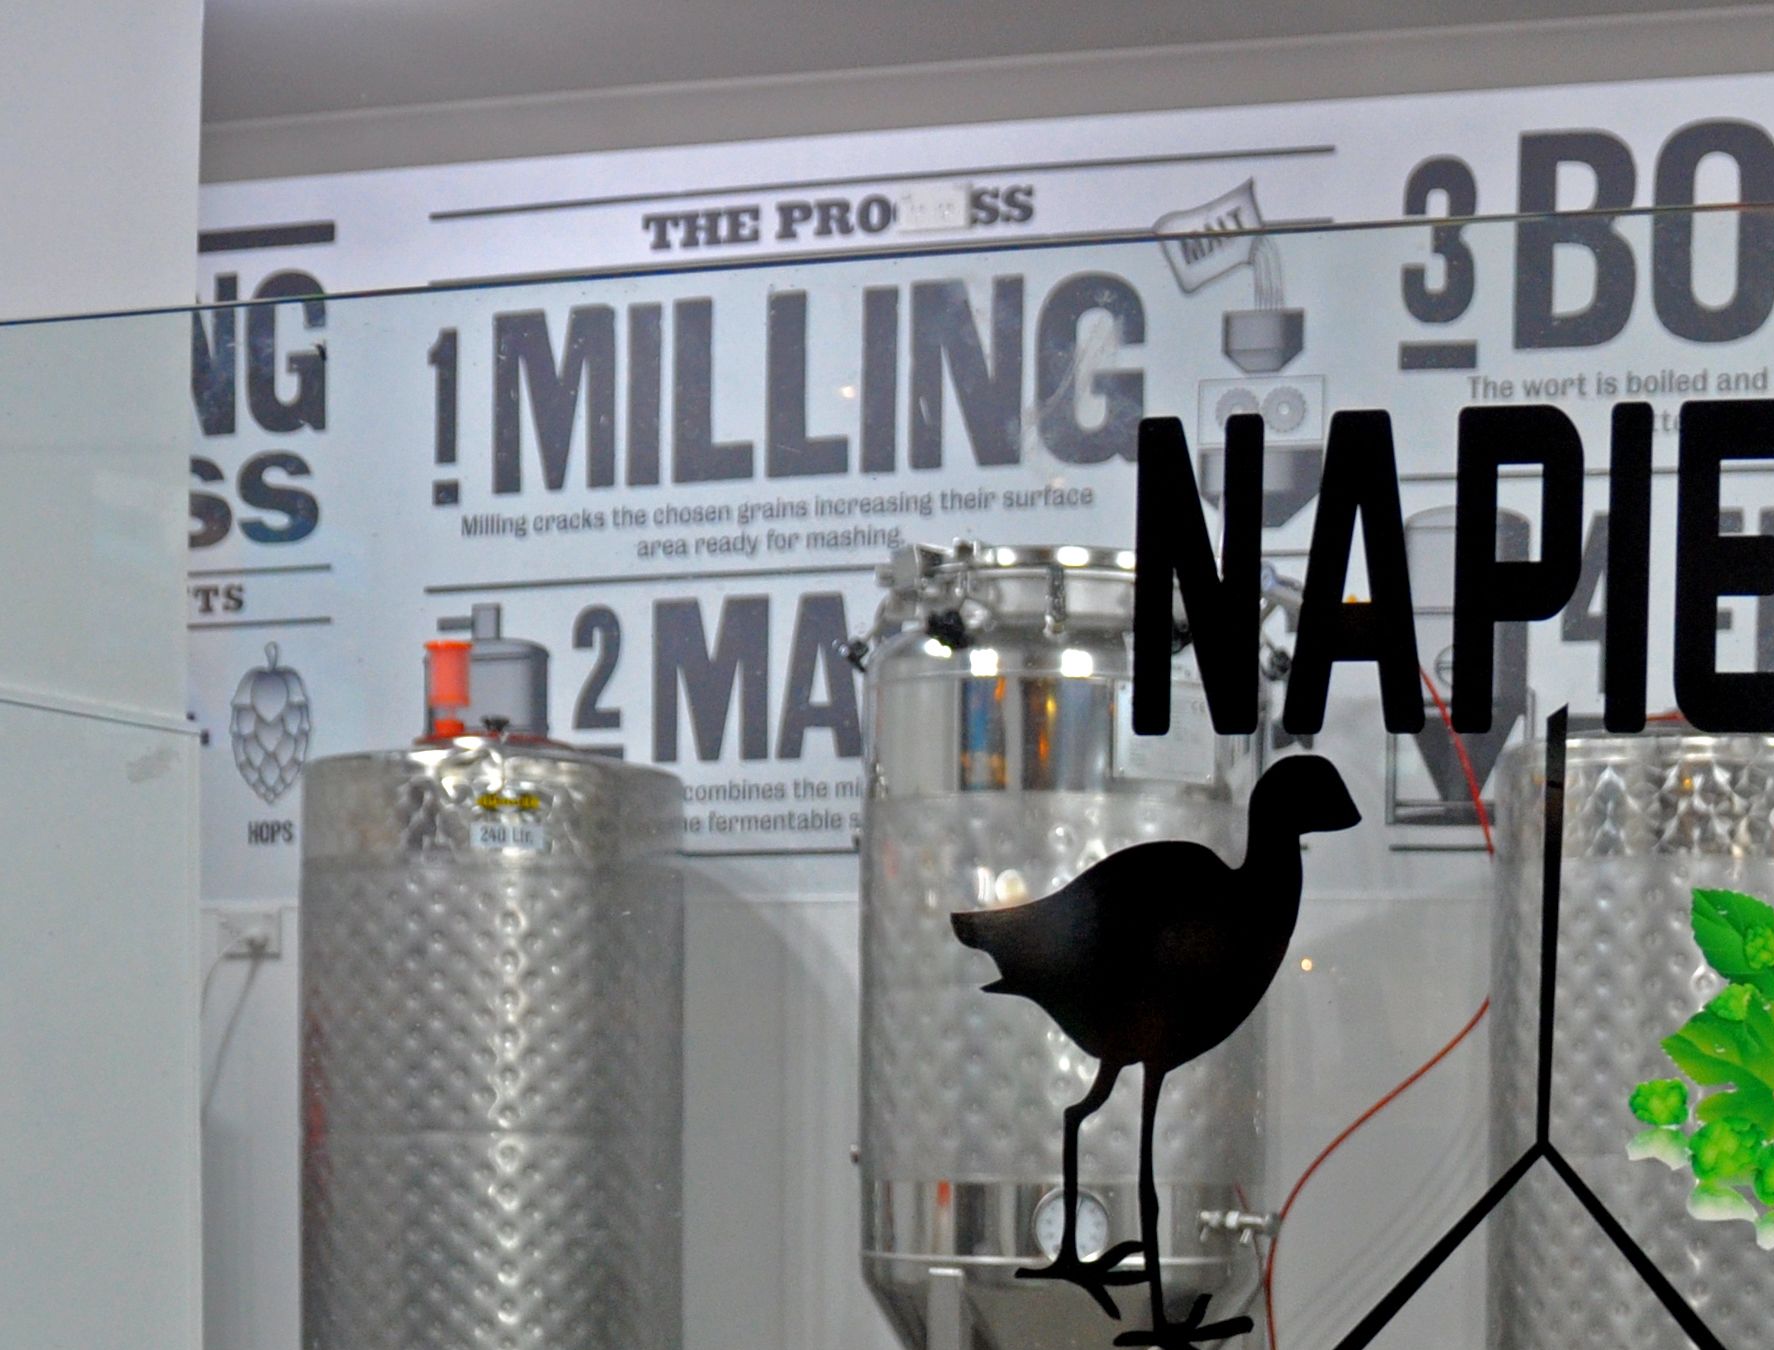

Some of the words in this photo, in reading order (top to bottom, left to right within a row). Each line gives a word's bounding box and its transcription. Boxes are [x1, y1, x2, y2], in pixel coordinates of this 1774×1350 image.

[642, 203, 760, 250] THE
[775, 184, 1034, 240] PROSS
[1402, 155, 1478, 324] 3
[427, 327, 458, 465] 1
[491, 270, 1146, 496] MILLING
[1467, 375, 1514, 399] The
[1522, 374, 1587, 398] wort
[1596, 372, 1618, 396] is
[1626, 369, 1708, 395] boiled
[1717, 368, 1768, 393] and
[460, 513, 528, 538] Milling
[533, 509, 605, 533] cracks
[612, 506, 647, 527] the
[653, 502, 731, 525] chosen
[737, 496, 807, 525] grains
[815, 490, 933, 518] increasing
[940, 486, 996, 511] their
[1002, 484, 1094, 509] surface
[636, 539, 687, 560] area
[695, 531, 759, 557] ready
[766, 528, 799, 551] for
[570, 604, 622, 729] 2
[652, 592, 863, 763] MA
[683, 778, 786, 801] combines
[793, 777, 828, 799] the
[248, 820, 294, 844] HOPS
[708, 809, 842, 833] fermentable
